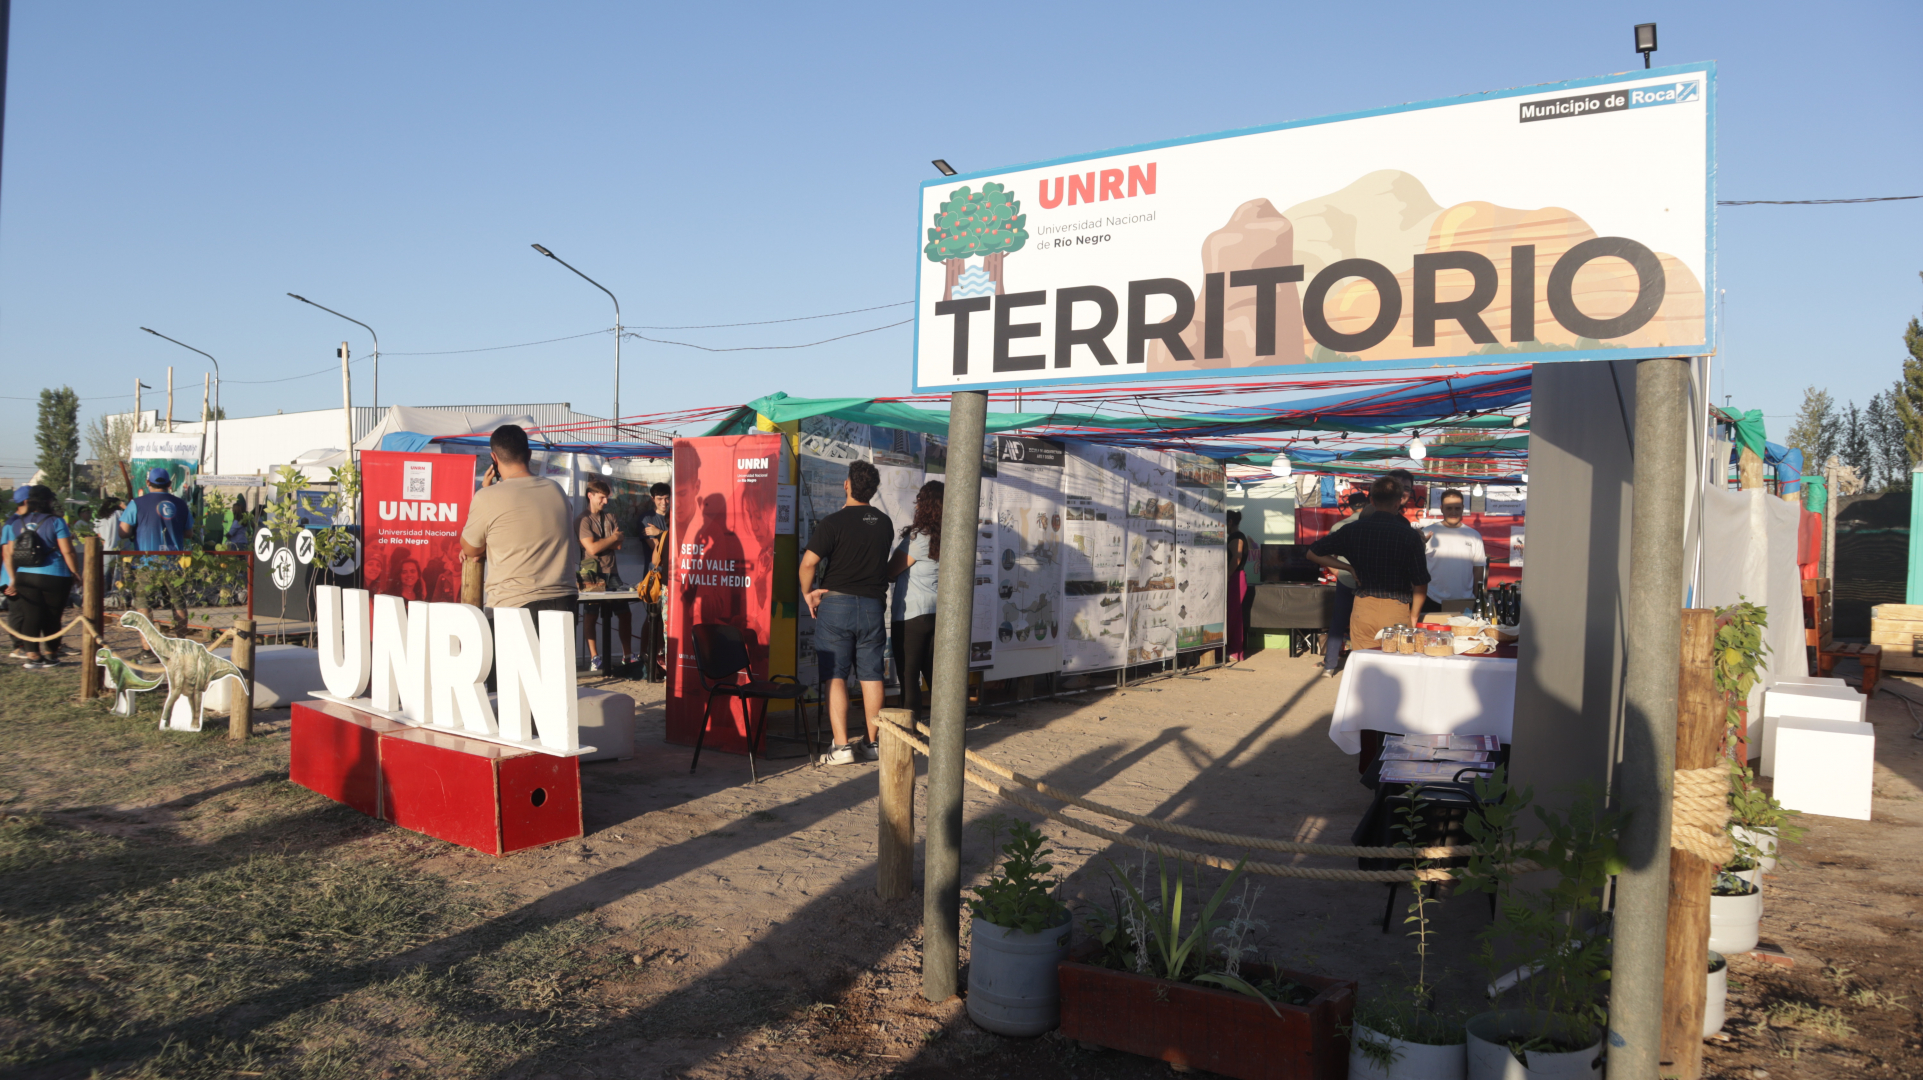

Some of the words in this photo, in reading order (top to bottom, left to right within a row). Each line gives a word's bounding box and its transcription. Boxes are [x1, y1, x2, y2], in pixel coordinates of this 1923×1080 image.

[1521, 97, 1600, 119] Municipio
[1604, 94, 1626, 108] de
[1631, 89, 1676, 105] Roca
[1039, 162, 1156, 209] UNRN
[1037, 217, 1102, 236] Universidad
[1106, 210, 1156, 227] Nacional
[1036, 240, 1050, 250] de
[1053, 236, 1072, 248] Río
[1076, 233, 1111, 246] Negro
[934, 236, 1666, 376] TERRITORIO
[737, 457, 769, 470] UNRN
[379, 501, 458, 522] UNRN
[378, 528, 423, 536] Universidad
[424, 529, 457, 537] Nacional
[390, 537, 403, 545] Río
[405, 538, 429, 546] Negro
[681, 543, 705, 555] SEDE
[680, 558, 703, 570] ALTO
[706, 559, 735, 572] VALLE
[681, 573, 686, 585] Y
[688, 573, 718, 586] VALLE
[720, 575, 751, 588] MEDIO
[316, 584, 580, 751] UNRN
